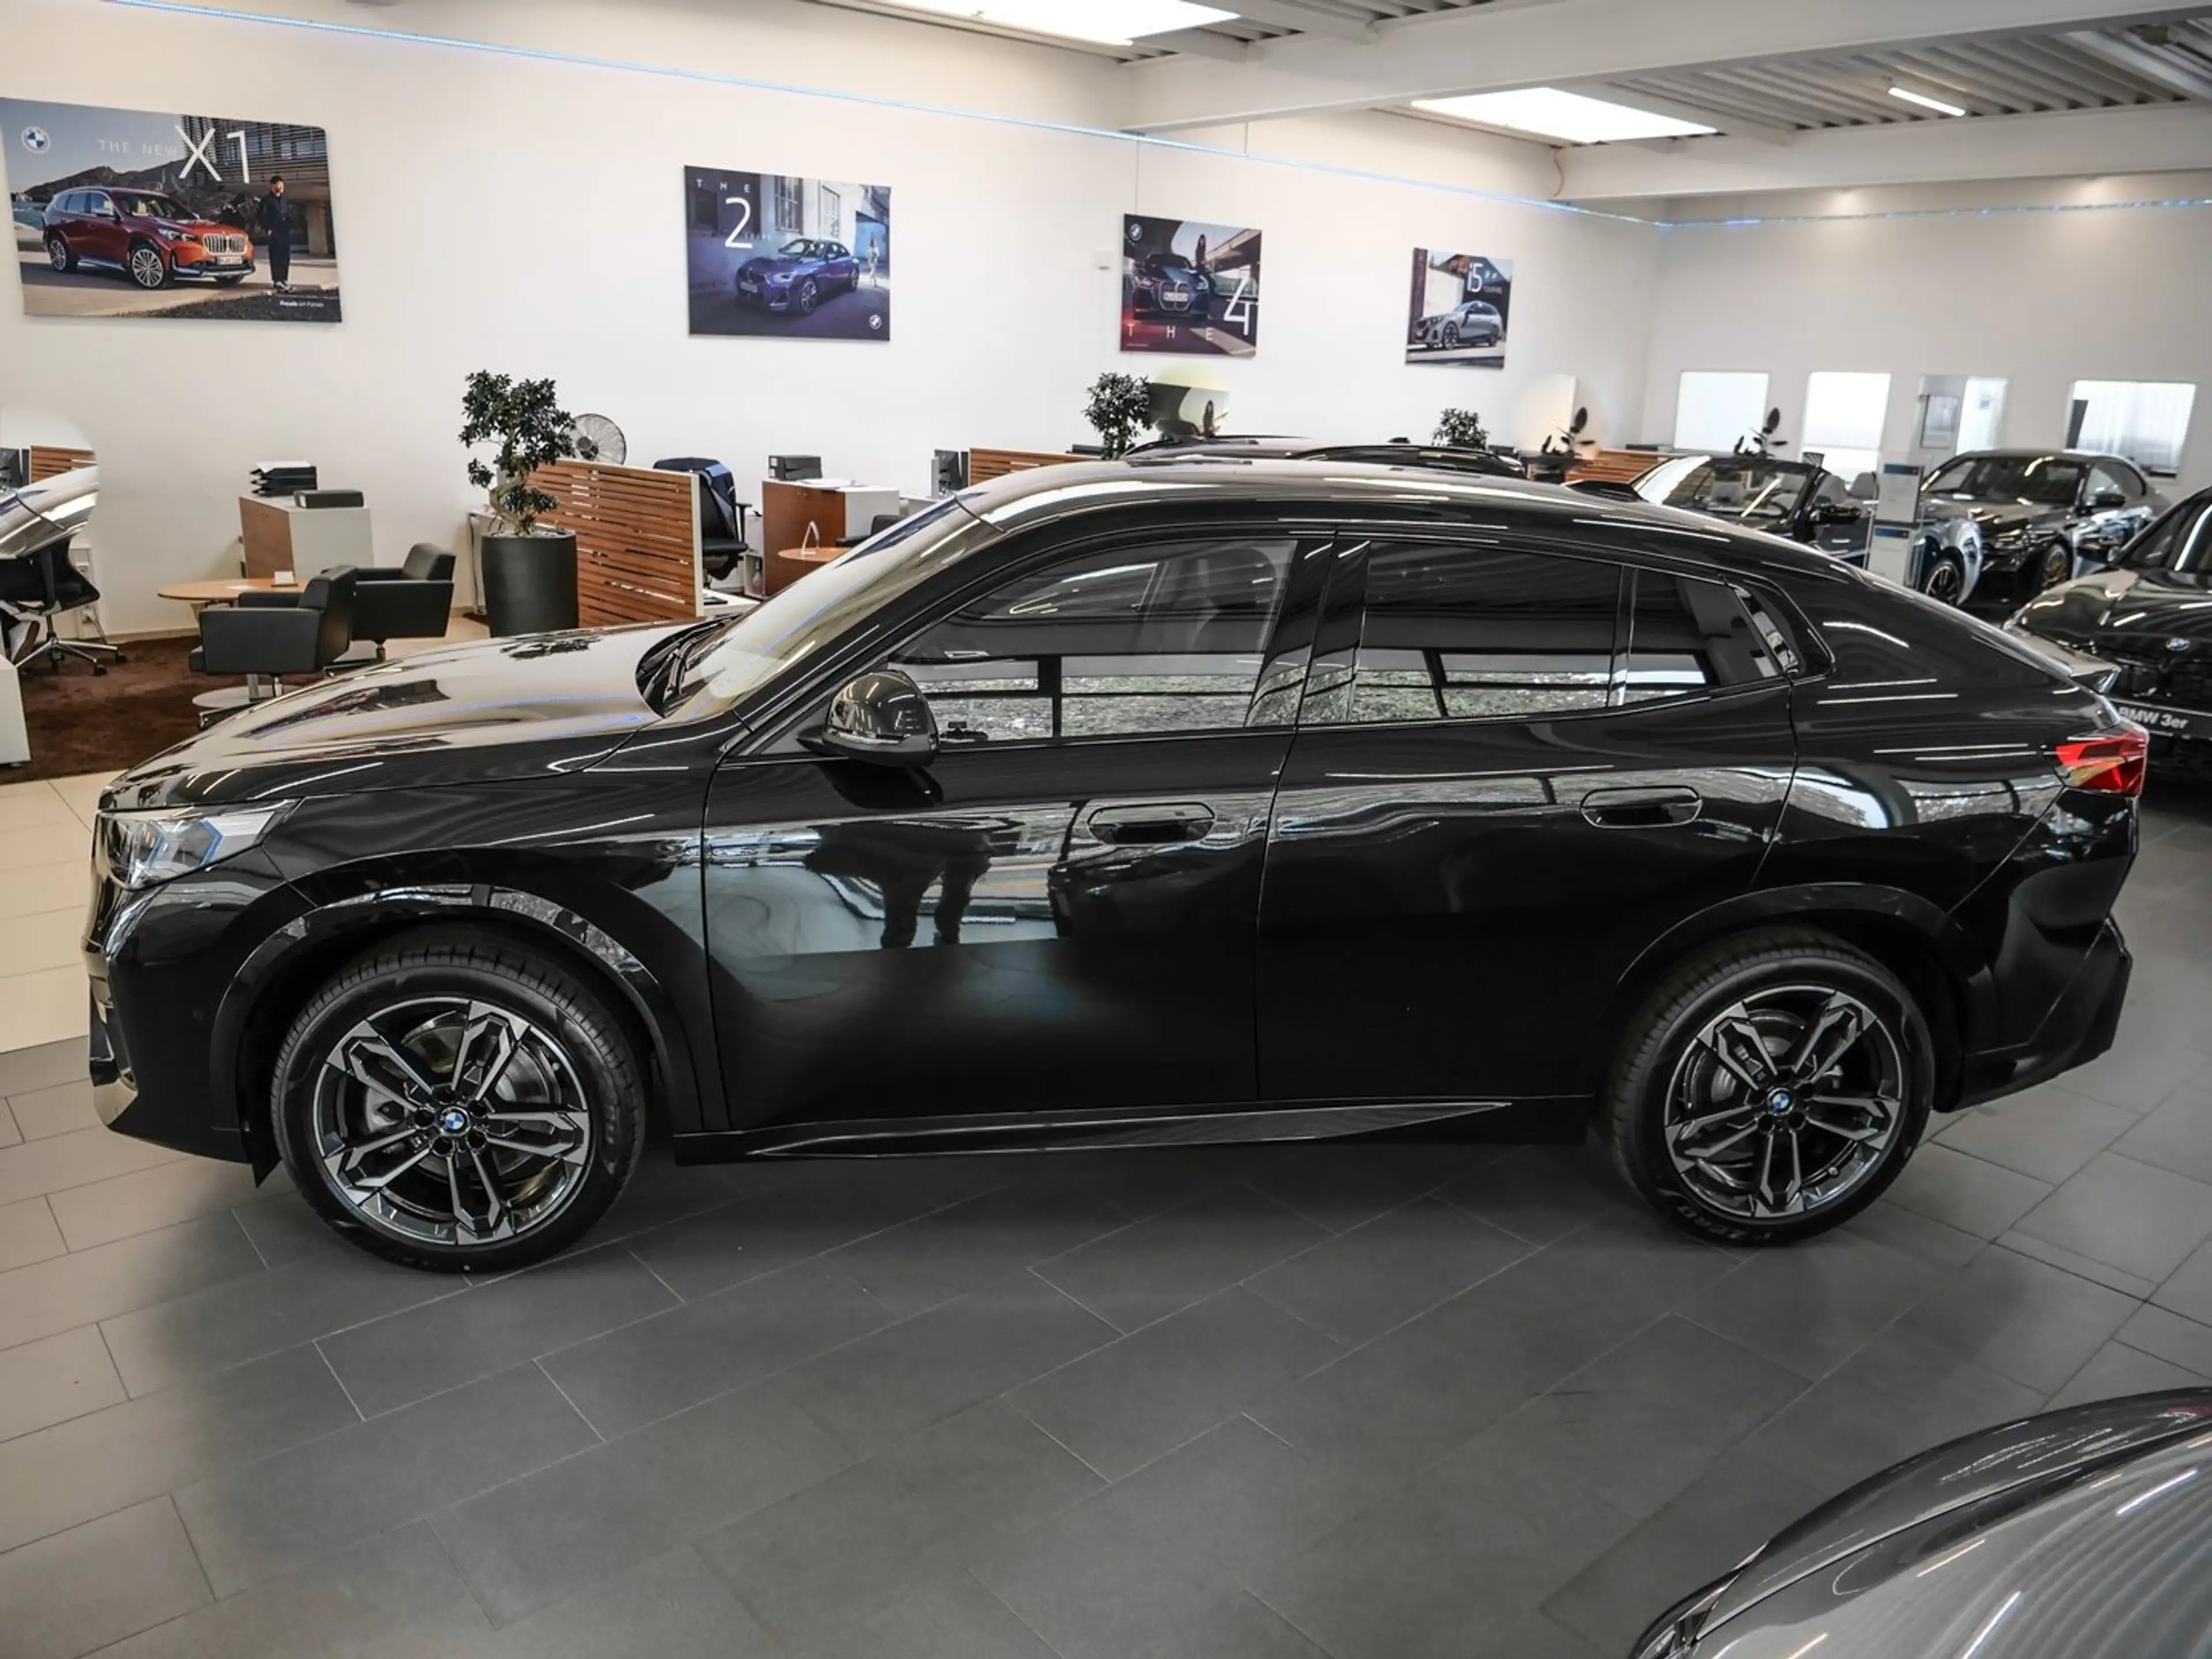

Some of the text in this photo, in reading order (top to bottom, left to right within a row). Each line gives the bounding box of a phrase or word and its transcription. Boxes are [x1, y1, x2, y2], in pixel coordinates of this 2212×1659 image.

[99, 139, 178, 157] THE NEW
[175, 124, 250, 184] X1
[696, 179, 751, 194] THE
[725, 196, 753, 249] 2
[1224, 268, 1251, 336] 4
[1127, 323, 1214, 341] THE
[2119, 706, 2188, 729] BMW 3er
